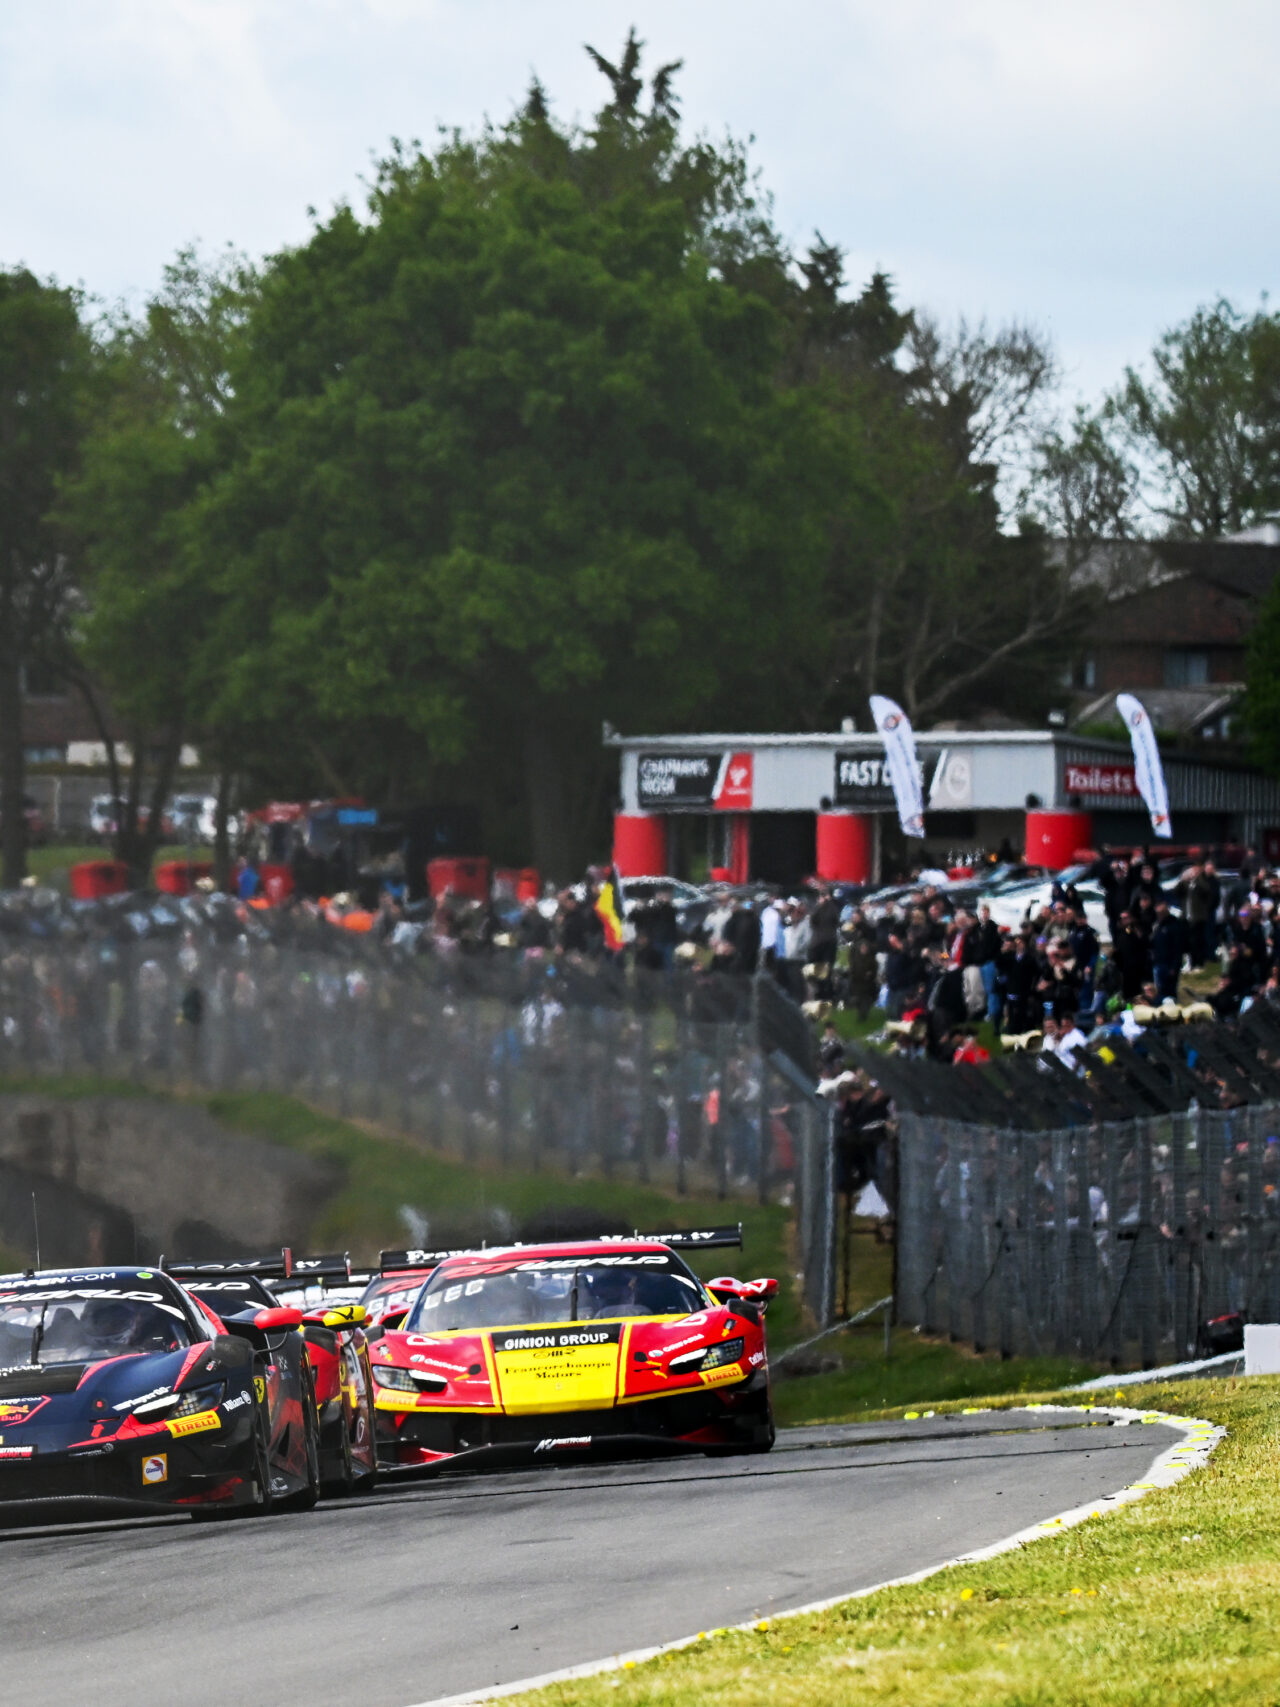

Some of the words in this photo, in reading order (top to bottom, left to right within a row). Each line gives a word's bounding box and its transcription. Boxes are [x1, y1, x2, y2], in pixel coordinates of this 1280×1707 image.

[840, 760, 881, 786] FAST
[1068, 768, 1132, 791] Toilets
[504, 1335, 555, 1350] GINION
[560, 1332, 609, 1346] GROUP
[172, 1413, 217, 1434] PIRELLI
